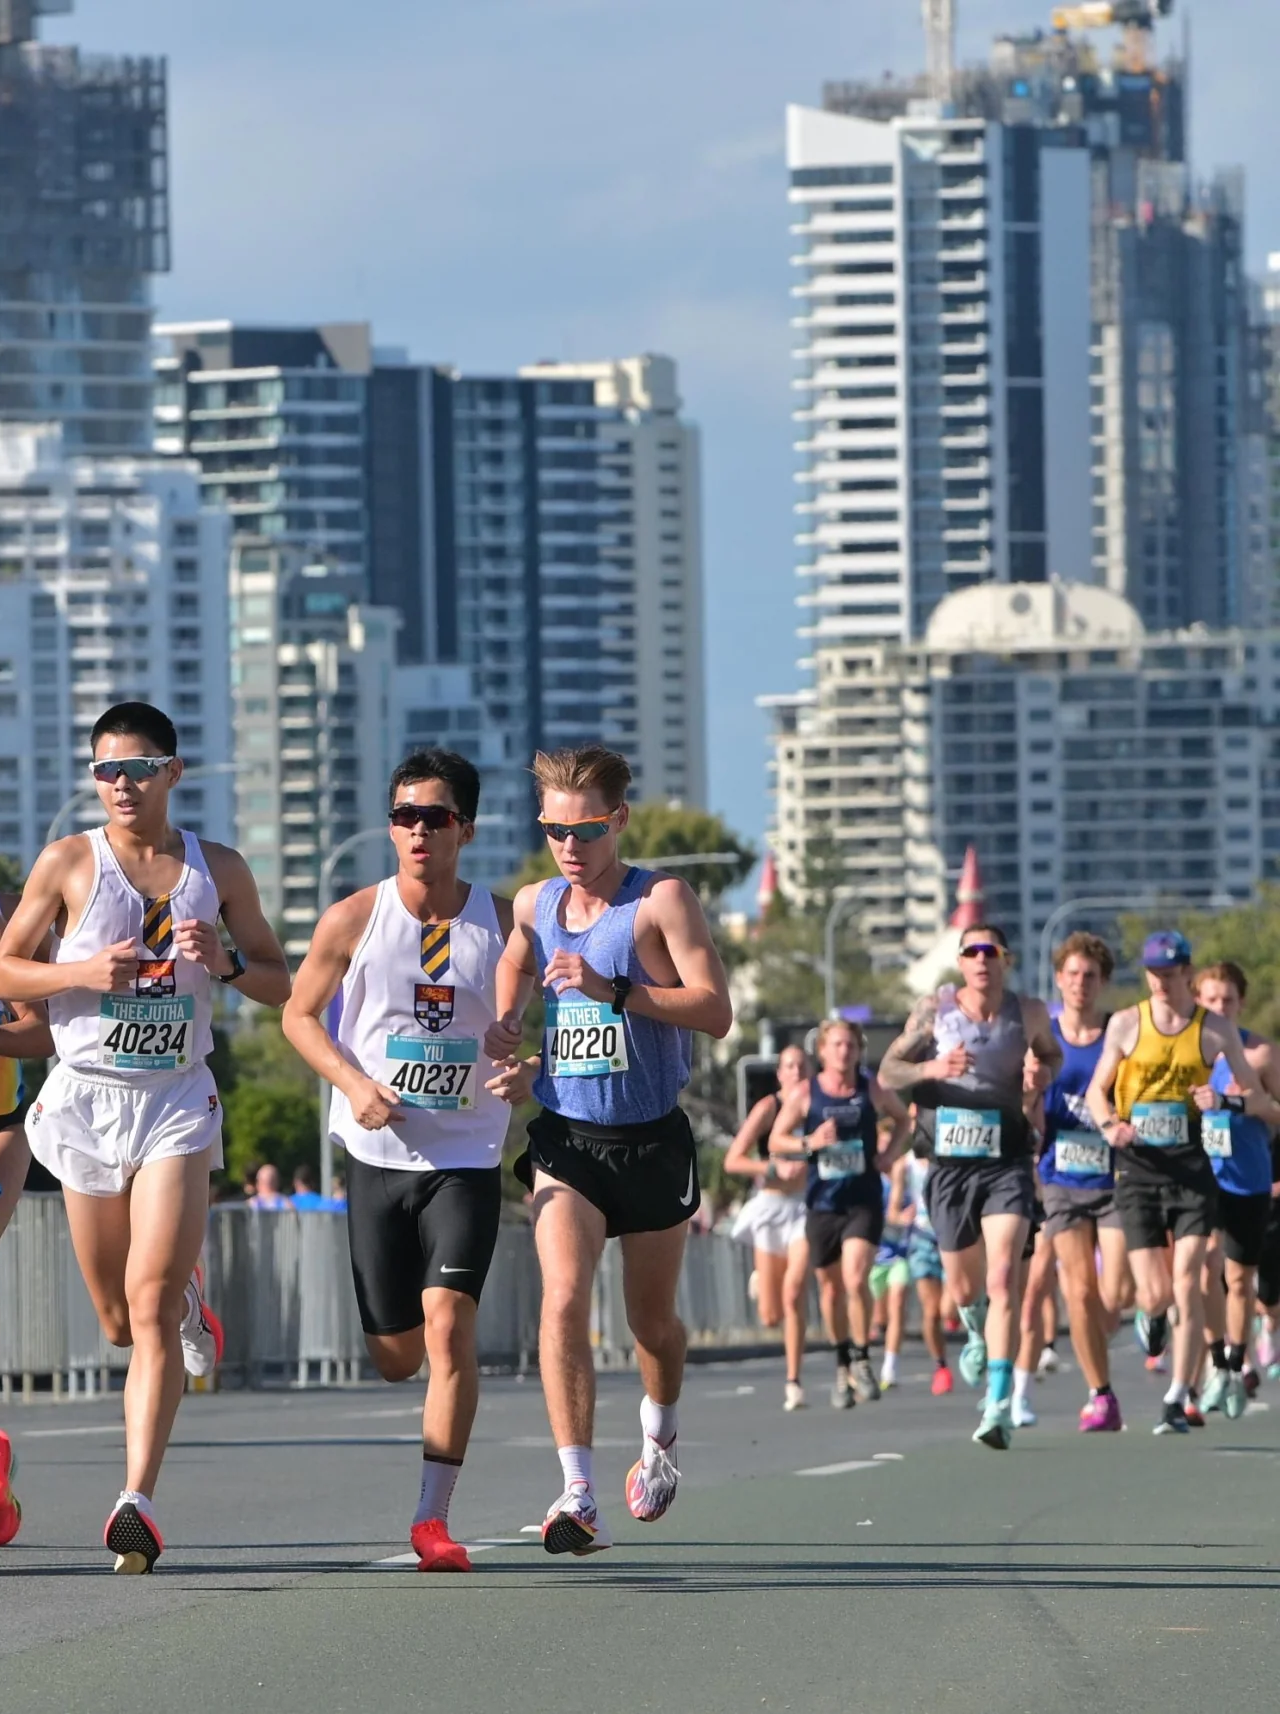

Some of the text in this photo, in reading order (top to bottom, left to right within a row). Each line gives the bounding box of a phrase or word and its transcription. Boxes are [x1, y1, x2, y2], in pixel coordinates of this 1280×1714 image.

[111, 1002, 185, 1020] THEEJUTHA
[103, 1022, 187, 1055] 40234
[550, 1025, 617, 1060] 40220
[423, 1044, 444, 1061] YIU
[390, 1062, 472, 1095] 40237
[944, 1125, 994, 1146] 40174
